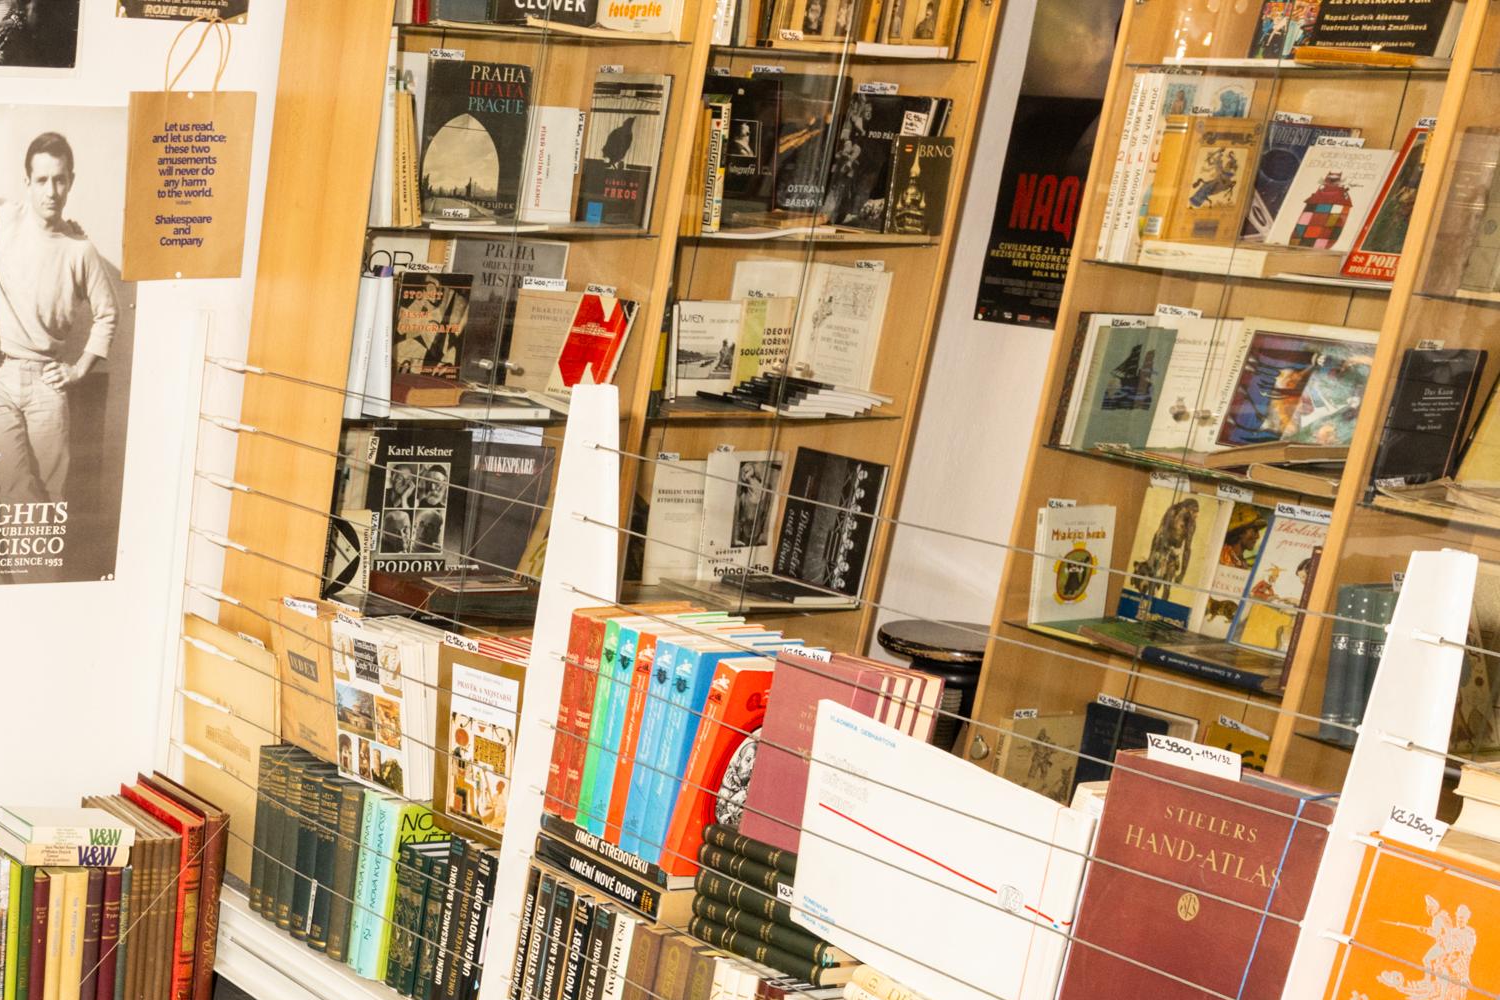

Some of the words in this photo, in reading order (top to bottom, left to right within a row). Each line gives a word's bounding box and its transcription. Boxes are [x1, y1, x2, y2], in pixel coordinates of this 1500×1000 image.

[144, 5, 173, 15] ROXIE
[470, 64, 527, 84] PRAHA
[467, 96, 524, 114] PRAGUE
[165, 122, 177, 131] Let
[152, 134, 168, 142] and
[170, 133, 181, 142] let
[165, 145, 188, 153] these
[919, 145, 954, 159] BRNO
[158, 156, 217, 165] amusements
[159, 167, 173, 176] will
[175, 168, 199, 176] never
[202, 166, 214, 175] do
[164, 179, 180, 189] any
[182, 178, 206, 187] harm
[158, 189, 166, 198] to
[168, 188, 182, 198] the
[184, 188, 213, 197] world.
[155, 215, 212, 226] Shakespeare
[173, 226, 191, 235] and
[160, 237, 203, 247] Company
[388, 445, 413, 457] Karel
[417, 445, 453, 458] Kestner
[14, 558, 42, 568] SINCE
[44, 557, 63, 567] 1953
[376, 558, 443, 573] PODOBY
[1163, 804, 1259, 844] STIELERS
[89, 828, 122, 846] V&W
[77, 845, 117, 866] V&W
[575, 829, 598, 852] UMĚNÍ
[599, 842, 649, 874] STŘEDOVĚKU
[1124, 824, 1284, 889] HAND-ATLAS
[570, 857, 594, 881] UMĚNÍ
[595, 871, 615, 892] NOVÉ
[615, 881, 637, 903] DOBY
